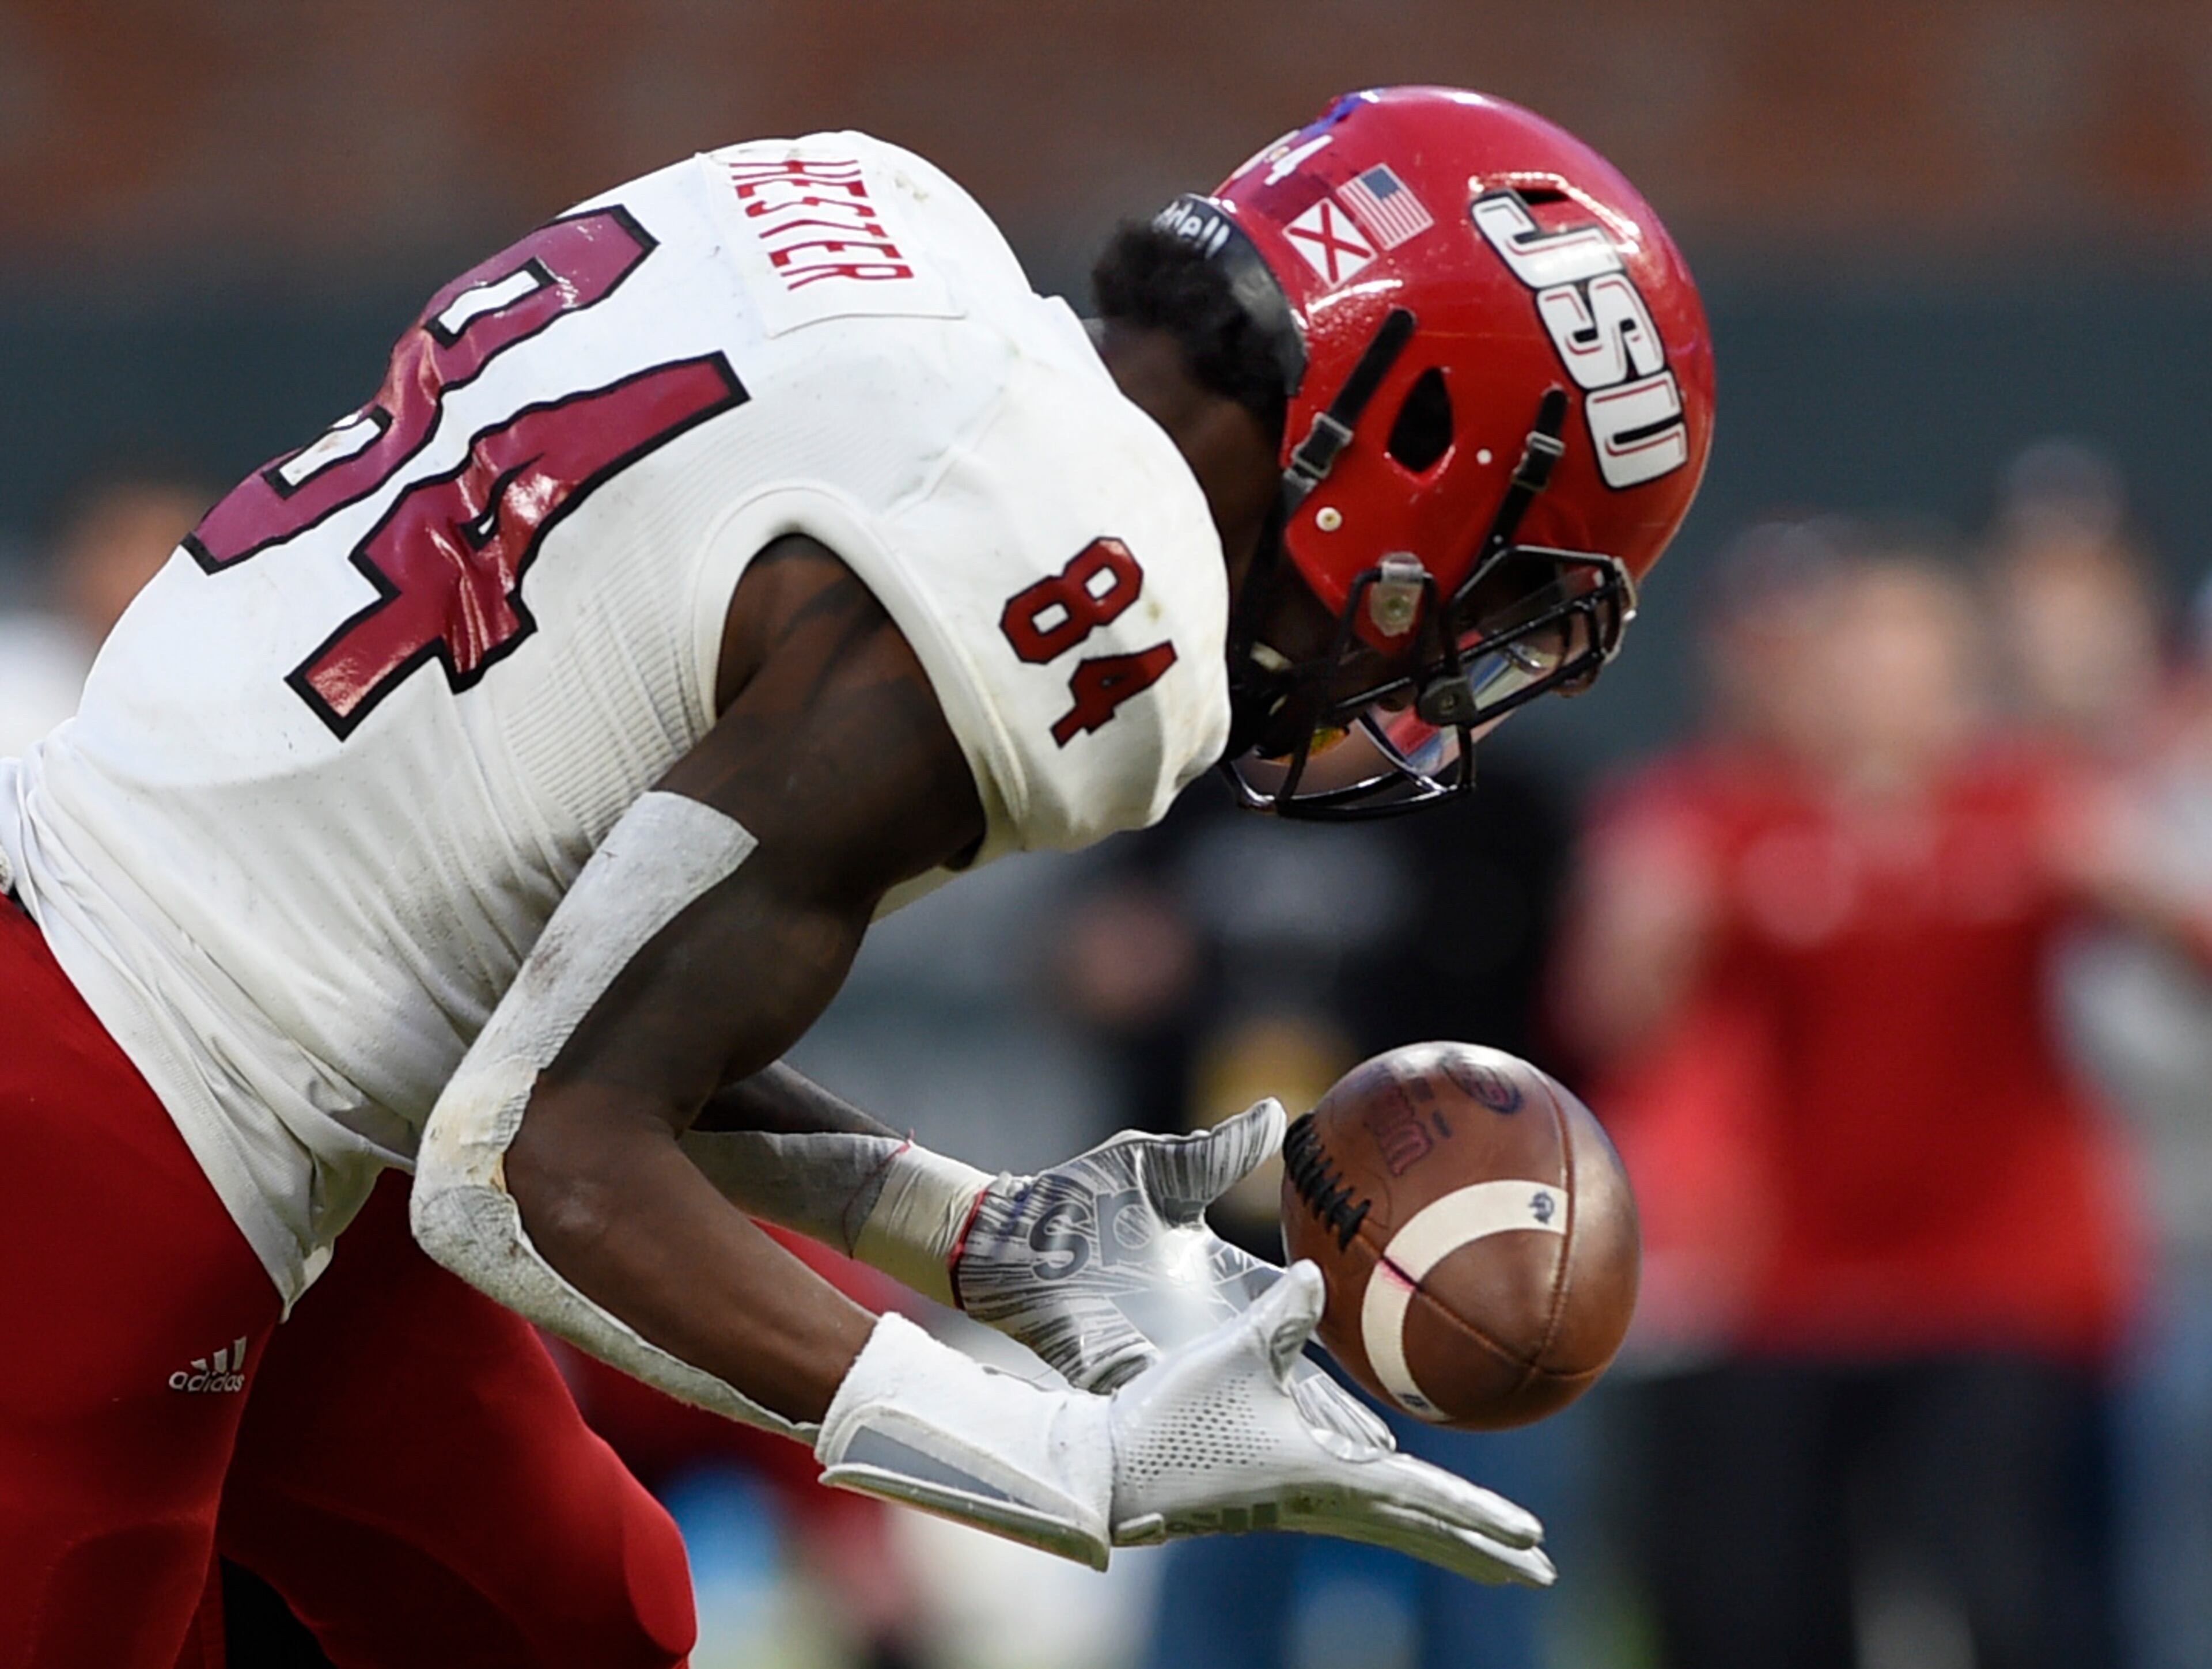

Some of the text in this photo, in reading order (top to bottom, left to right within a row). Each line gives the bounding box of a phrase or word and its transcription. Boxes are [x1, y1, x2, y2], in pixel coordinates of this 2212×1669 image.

[729, 160, 914, 291] HESTER
[1468, 187, 1687, 491] JSU
[181, 203, 751, 742] 84
[998, 536, 1178, 749] 84
[169, 1370, 245, 1392] adidas
